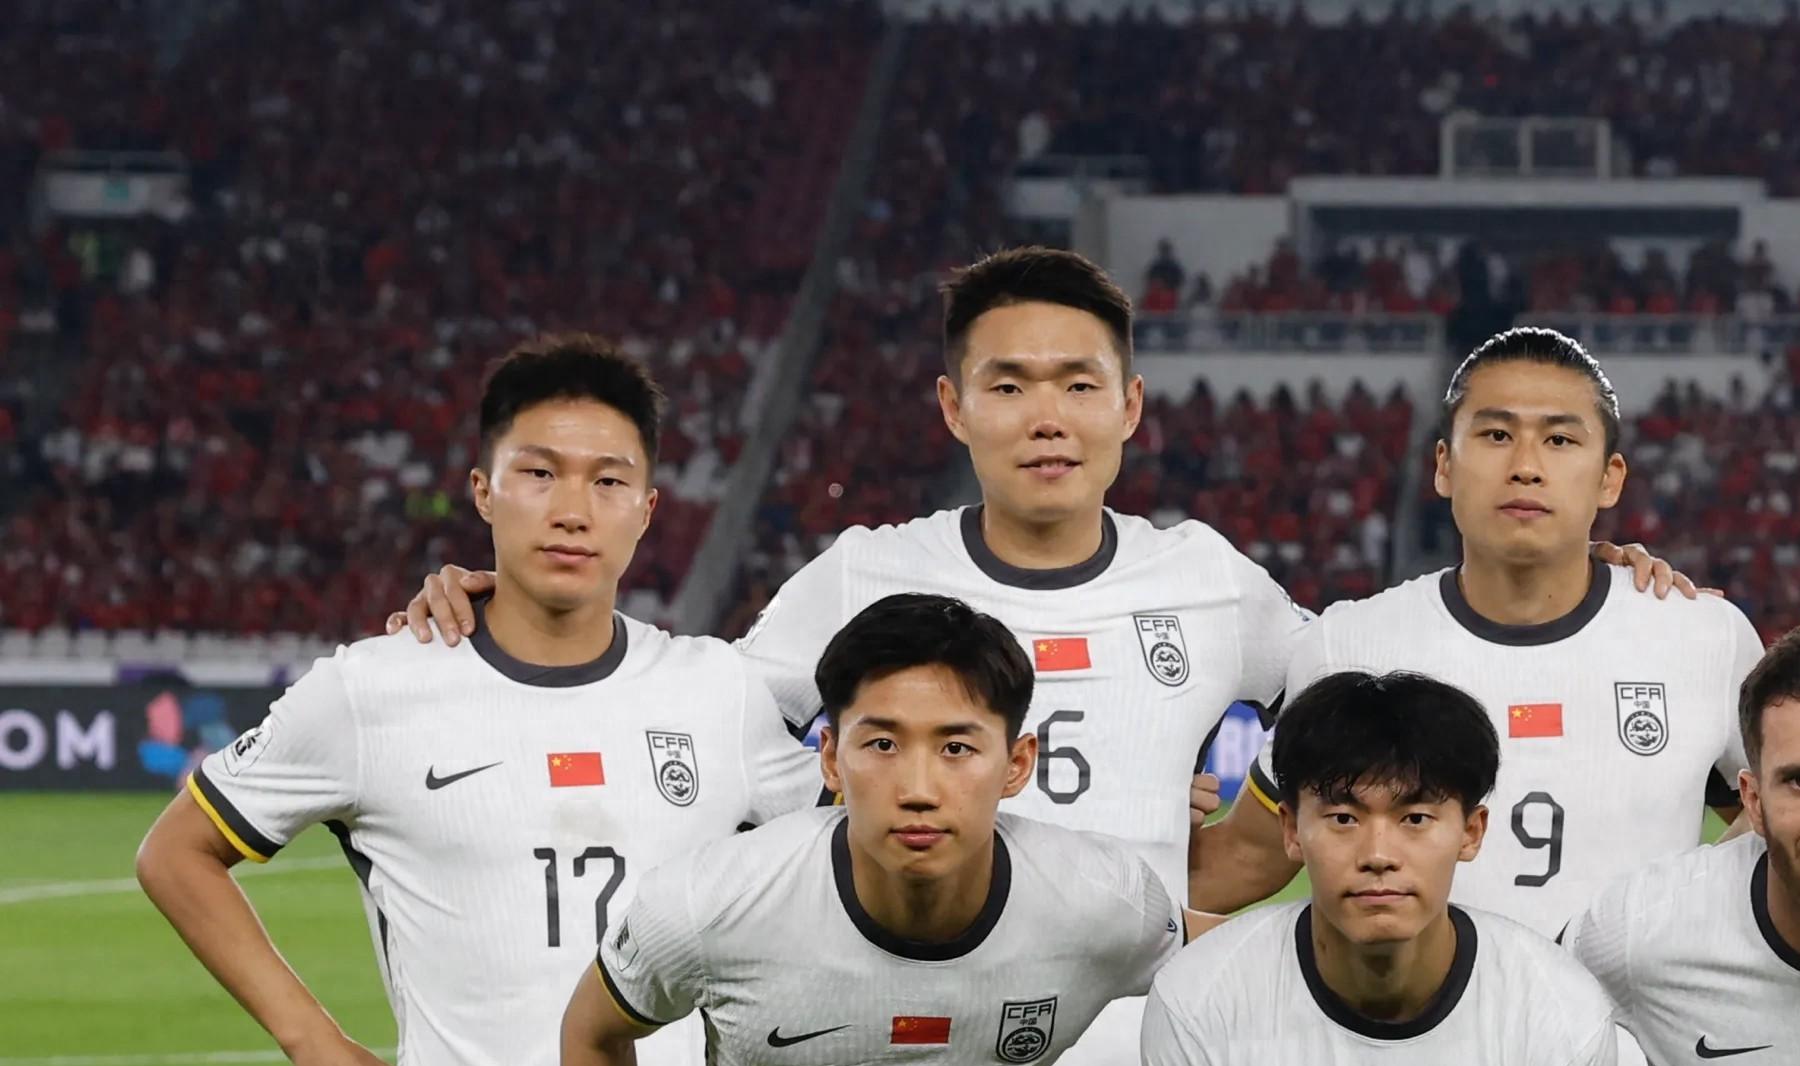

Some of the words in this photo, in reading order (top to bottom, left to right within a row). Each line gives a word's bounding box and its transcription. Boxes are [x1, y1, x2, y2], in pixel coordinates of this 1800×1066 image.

[1140, 620, 1178, 632] CFA
[1620, 687, 1661, 700] CFA
[652, 736, 690, 750] CFA
[1037, 710, 1090, 804] 6
[1511, 791, 1564, 887] 9
[533, 846, 625, 947] 17
[1007, 1003, 1051, 1019] CFA
